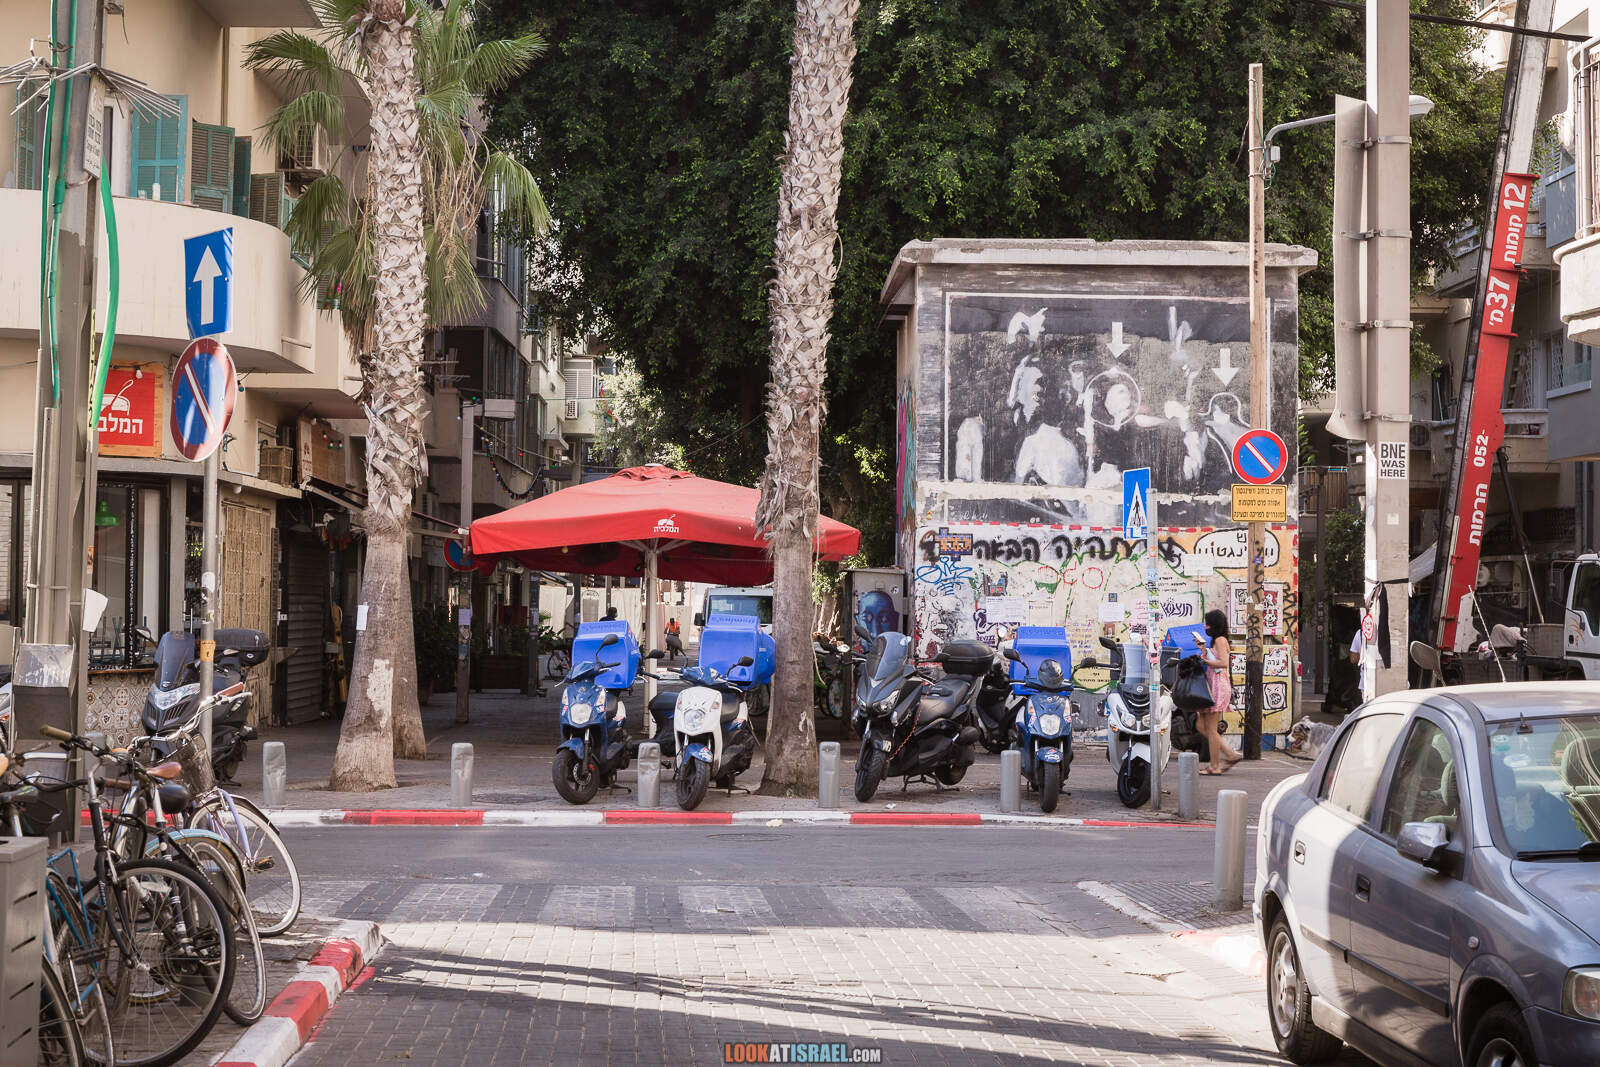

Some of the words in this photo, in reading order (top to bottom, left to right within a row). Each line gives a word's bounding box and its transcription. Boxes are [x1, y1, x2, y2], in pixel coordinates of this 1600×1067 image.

[1503, 182, 1527, 211] 12
[1503, 214, 1524, 265] קומות
[97, 412, 143, 435] המלב
[1380, 443, 1406, 459] BNE
[1380, 459, 1406, 468] WAS
[1380, 469, 1406, 478] HERE
[1469, 482, 1488, 547] הרמות
